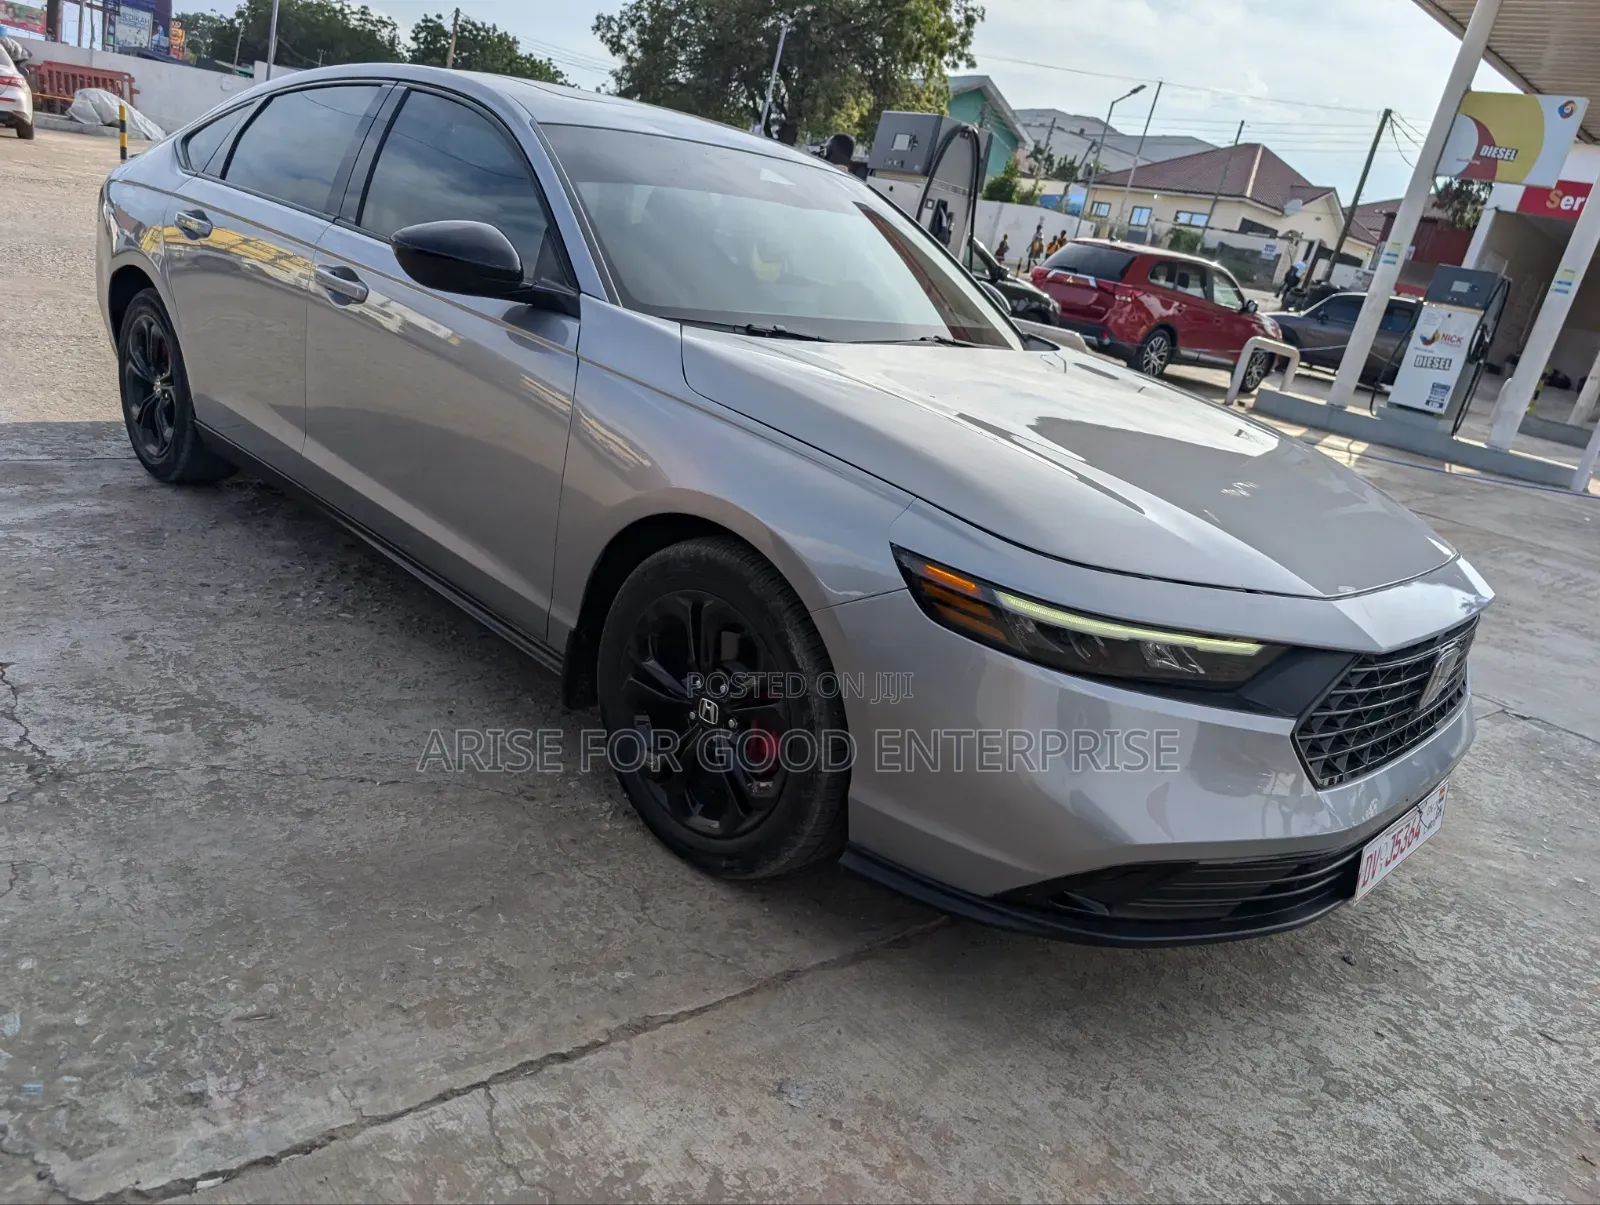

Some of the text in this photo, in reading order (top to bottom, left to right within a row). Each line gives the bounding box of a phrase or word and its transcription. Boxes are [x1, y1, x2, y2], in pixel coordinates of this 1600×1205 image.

[1480, 144, 1517, 161] DIESEL
[1545, 190, 1586, 211] Ser
[1441, 333, 1464, 344] NICK
[1414, 355, 1452, 371] DIESEL
[1362, 846, 1381, 888] DV
